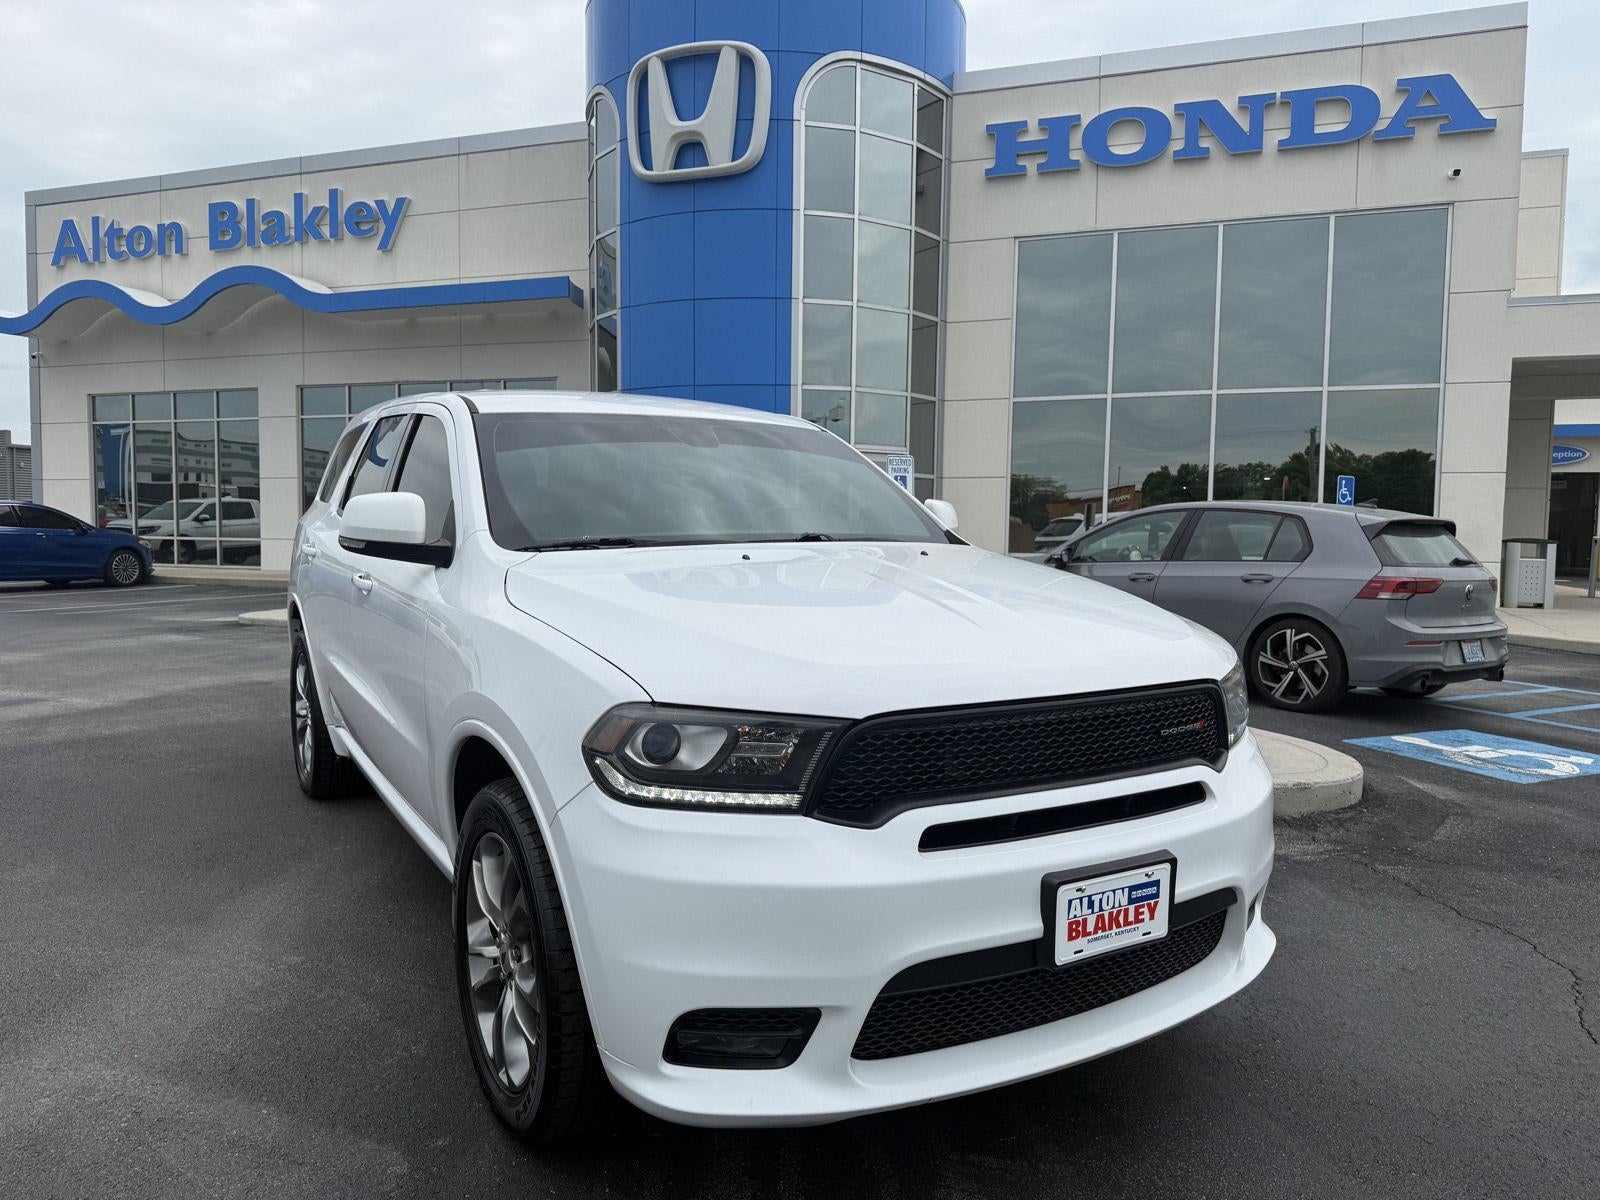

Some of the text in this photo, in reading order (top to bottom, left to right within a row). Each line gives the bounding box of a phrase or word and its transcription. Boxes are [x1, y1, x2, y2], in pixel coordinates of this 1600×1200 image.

[985, 74, 1497, 178] HONDA
[51, 188, 410, 267] Alton Blakley
[888, 458, 911, 466] RESERVED
[1552, 450, 1583, 459] eption
[890, 466, 910, 474] PARKING
[1161, 723, 1200, 735] DODGE
[1068, 888, 1129, 919] ALTON
[1067, 900, 1159, 942] BLAKLEY
[1086, 926, 1140, 944] SOMERSET, KENTUCKY
